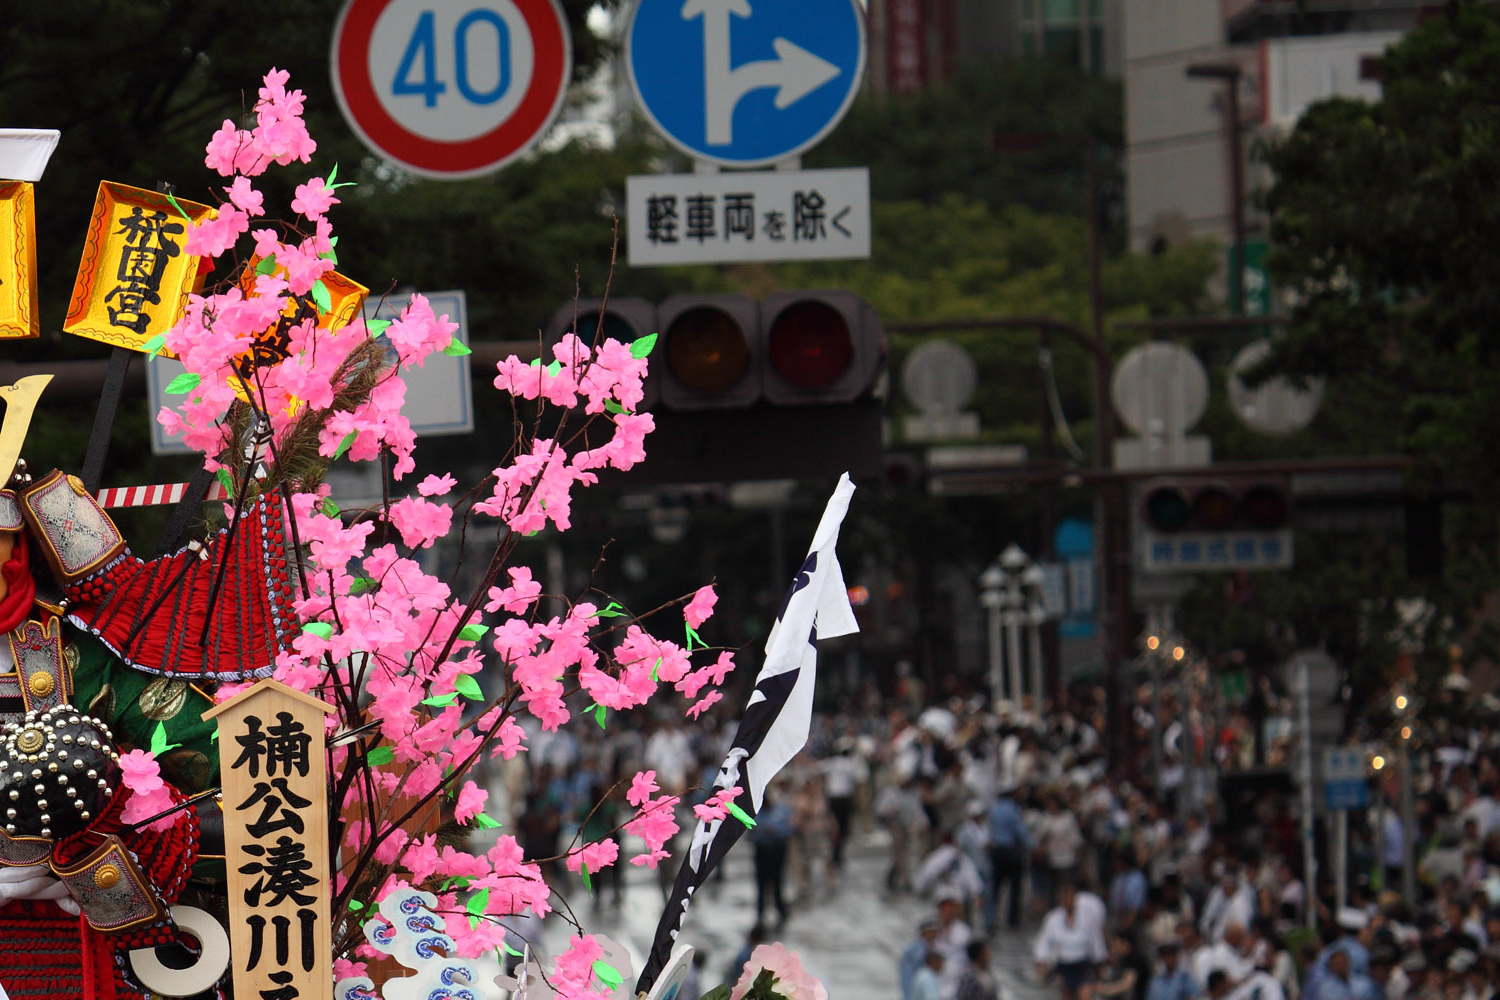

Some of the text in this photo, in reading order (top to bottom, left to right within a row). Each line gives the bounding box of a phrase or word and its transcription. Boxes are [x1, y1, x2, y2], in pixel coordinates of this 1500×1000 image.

[392, 8, 511, 108] 40
[646, 189, 852, 244] 軽車両を除く
[112, 207, 185, 335] 祇園宮
